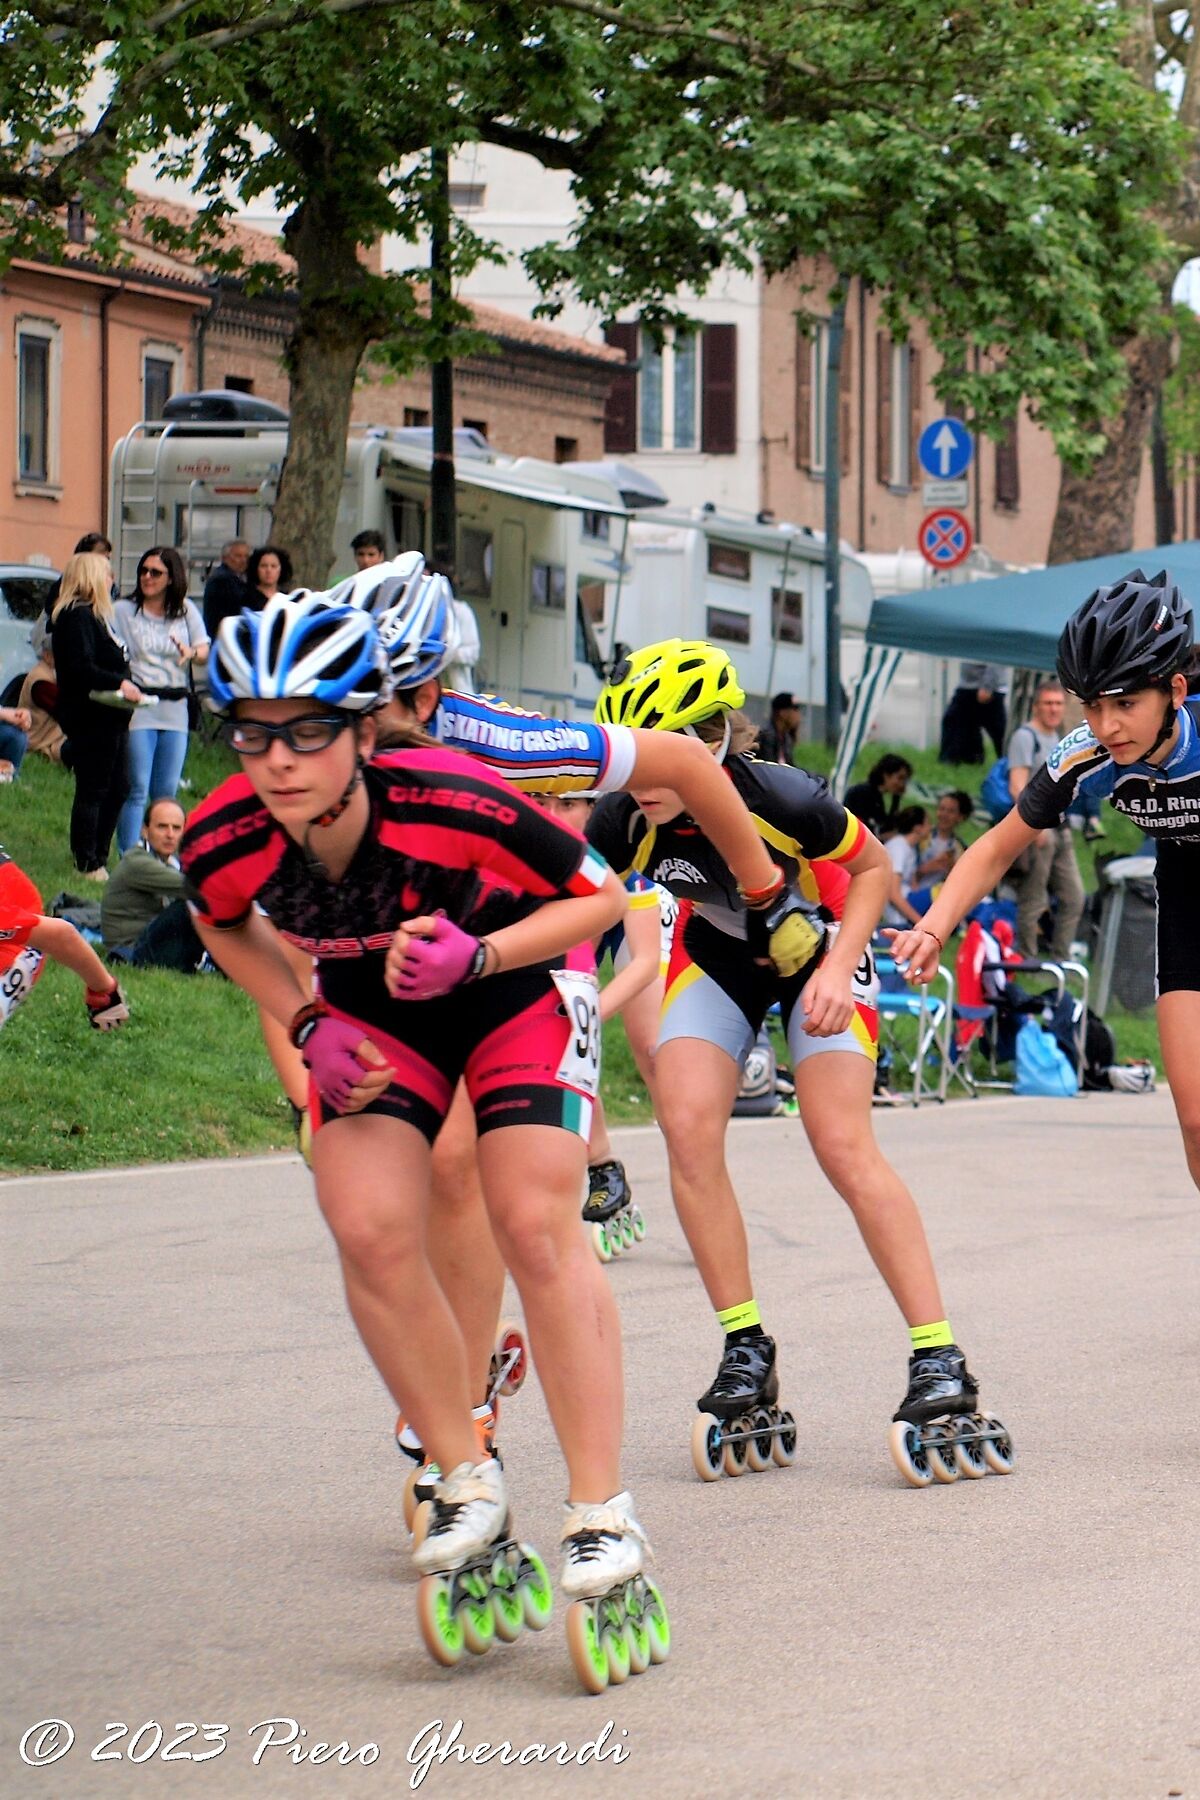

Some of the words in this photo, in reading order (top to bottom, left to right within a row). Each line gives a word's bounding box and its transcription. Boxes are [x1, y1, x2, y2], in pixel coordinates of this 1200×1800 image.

[443, 712, 523, 751] SKATING
[1115, 797, 1163, 814] A.S.D.
[653, 858, 708, 884] MELISSA
